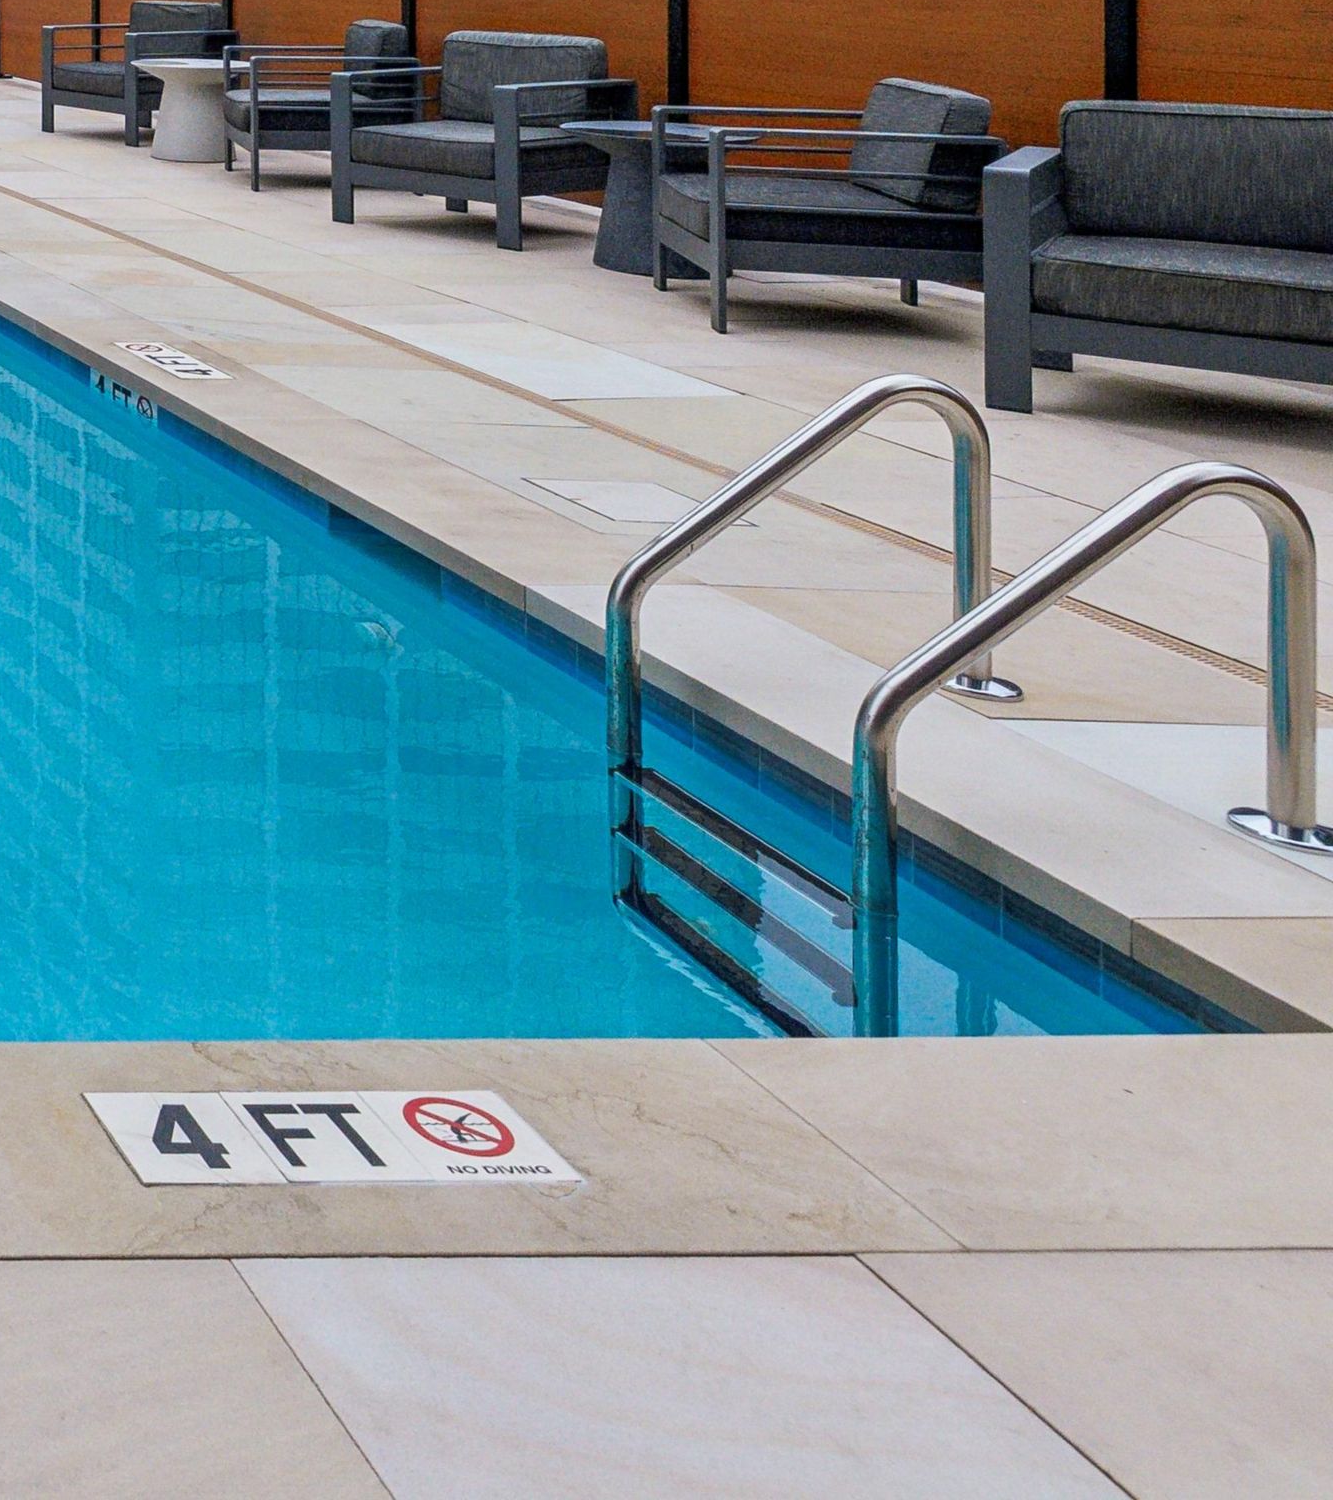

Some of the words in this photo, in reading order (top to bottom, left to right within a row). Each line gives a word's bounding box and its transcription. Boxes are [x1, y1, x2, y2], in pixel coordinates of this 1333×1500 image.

[145, 354, 200, 366] FT
[174, 368, 214, 376] 4
[95, 373, 106, 394] 4
[112, 381, 133, 408] FT
[151, 1103, 232, 1170] 4
[241, 1102, 388, 1168] FT
[446, 1164, 479, 1175] NO
[481, 1164, 553, 1175] DIVING
